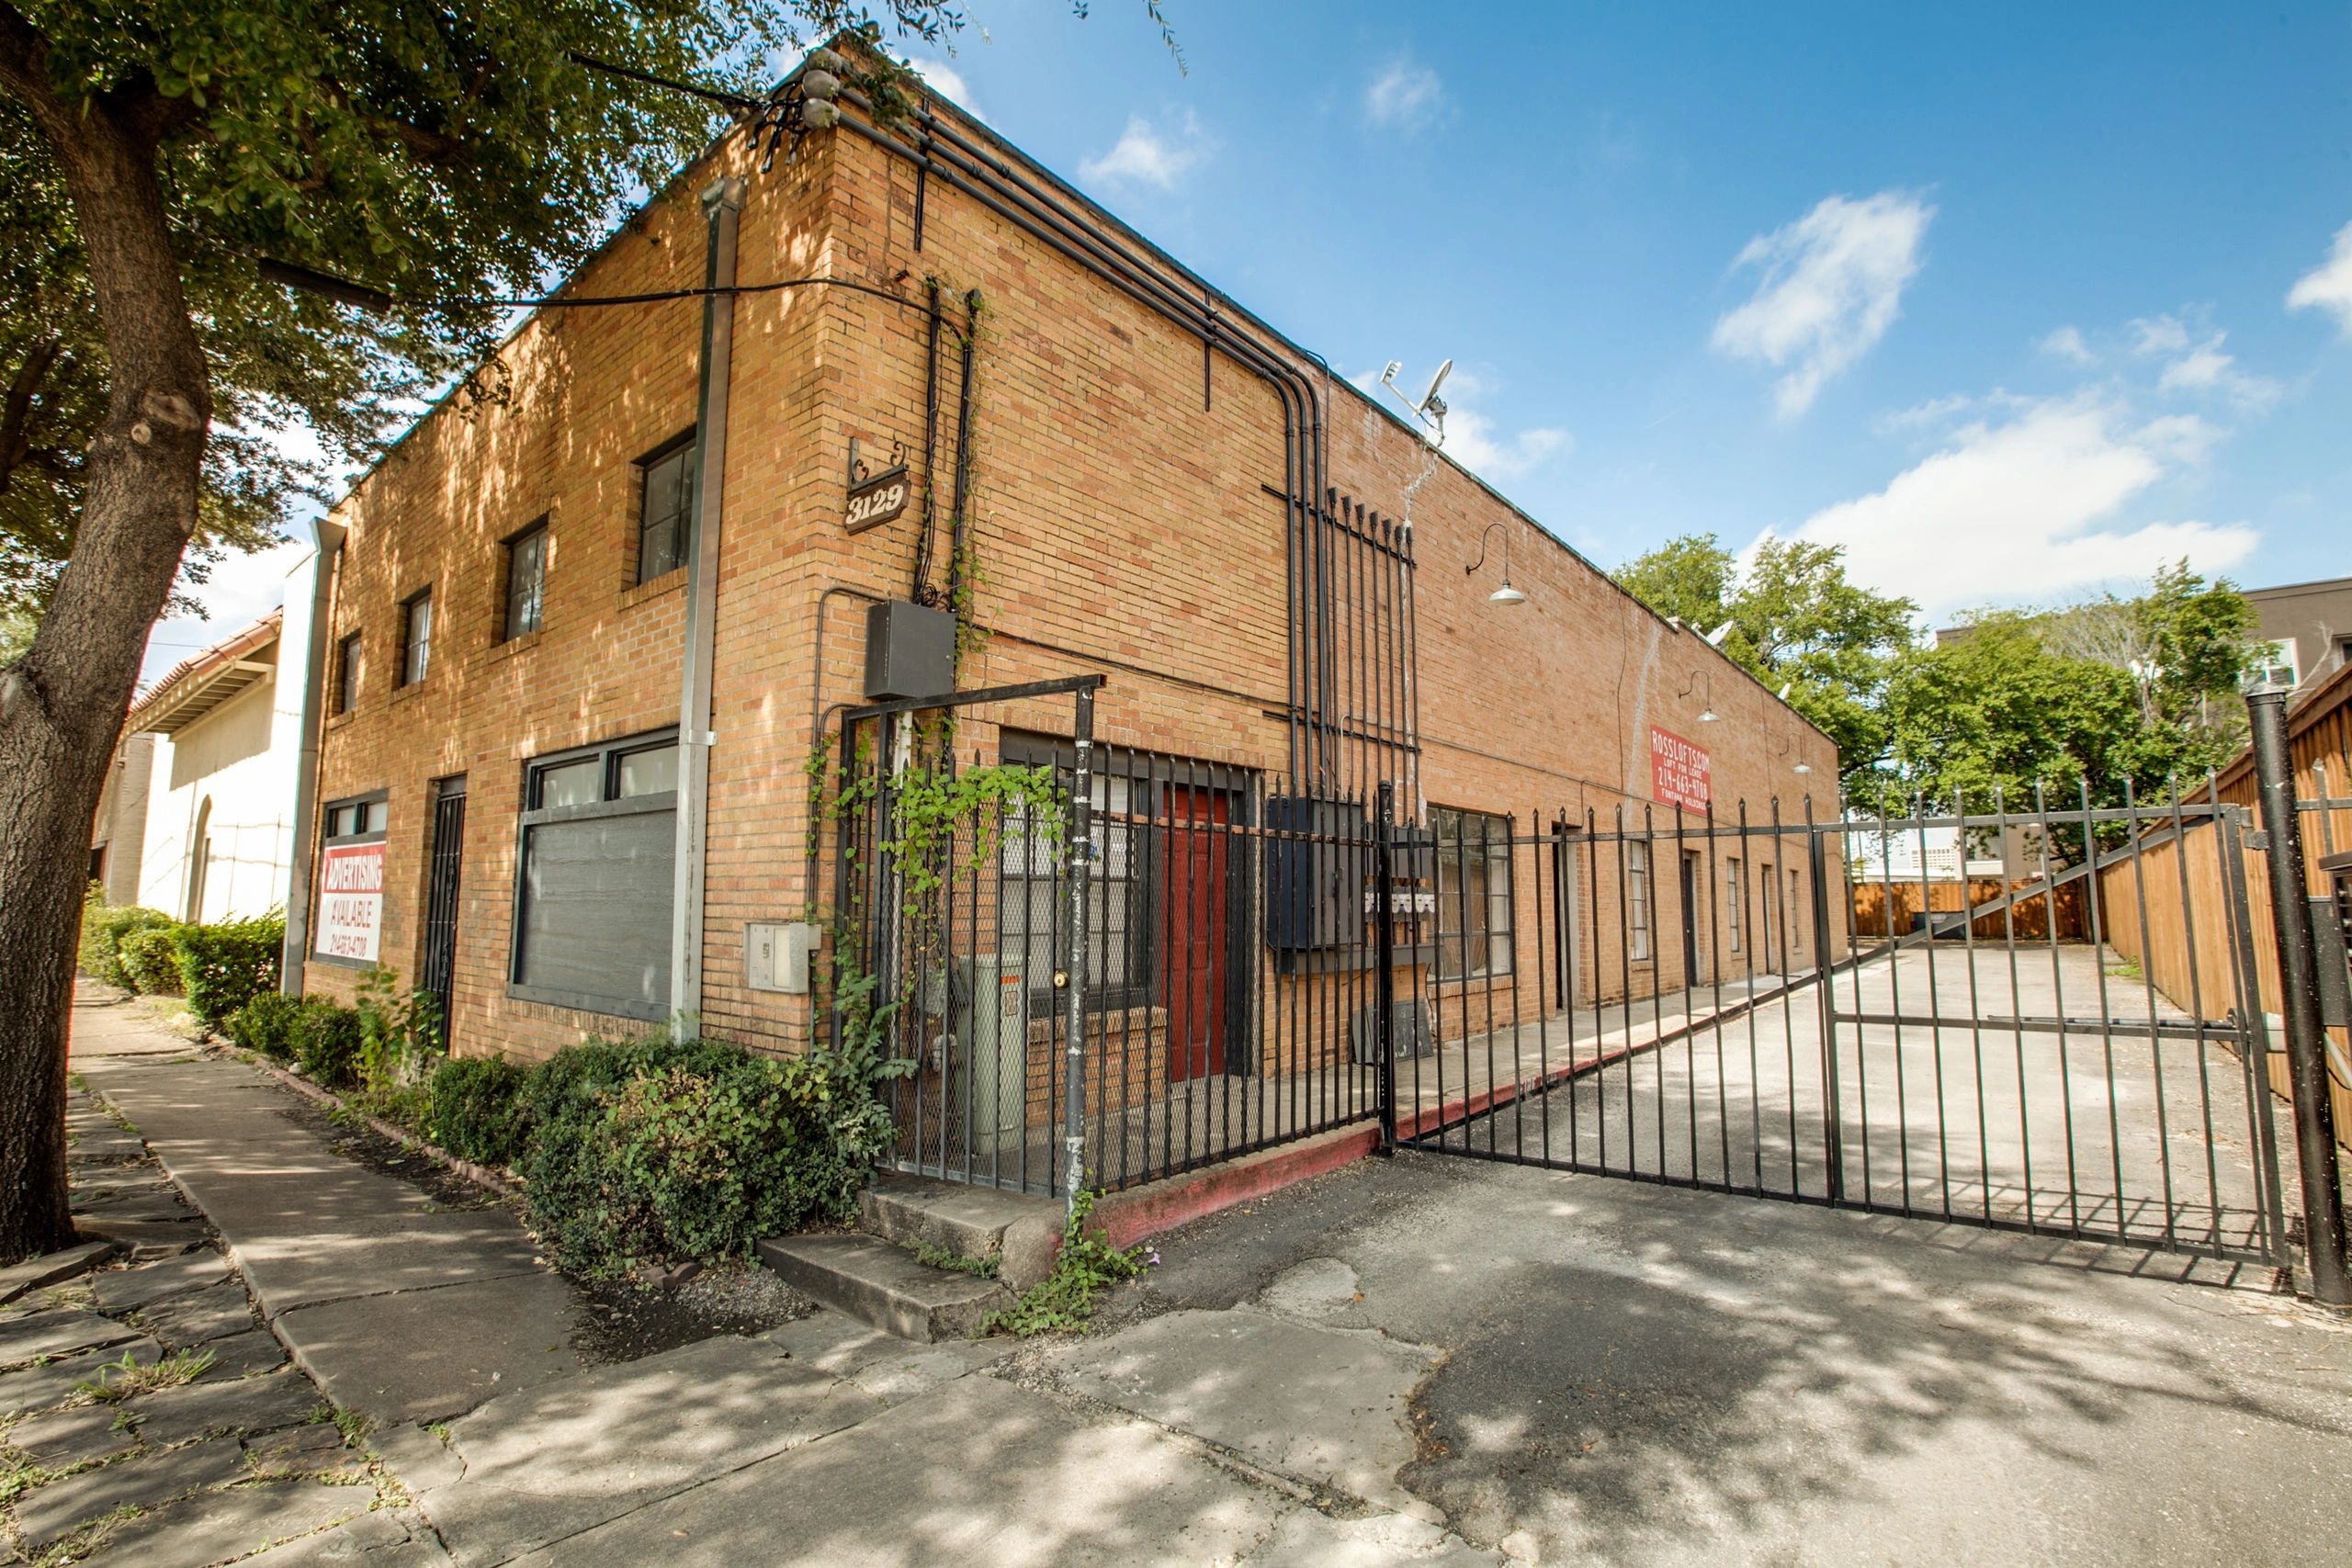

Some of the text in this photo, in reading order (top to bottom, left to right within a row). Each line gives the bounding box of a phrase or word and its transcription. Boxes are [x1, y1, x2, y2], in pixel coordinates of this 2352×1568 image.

[845, 484, 904, 525] 3129
[1663, 757, 1702, 780] LOFT FOR LEASE
[327, 853, 382, 890] ADVERTISING
[330, 899, 373, 929] AVAILABLE
